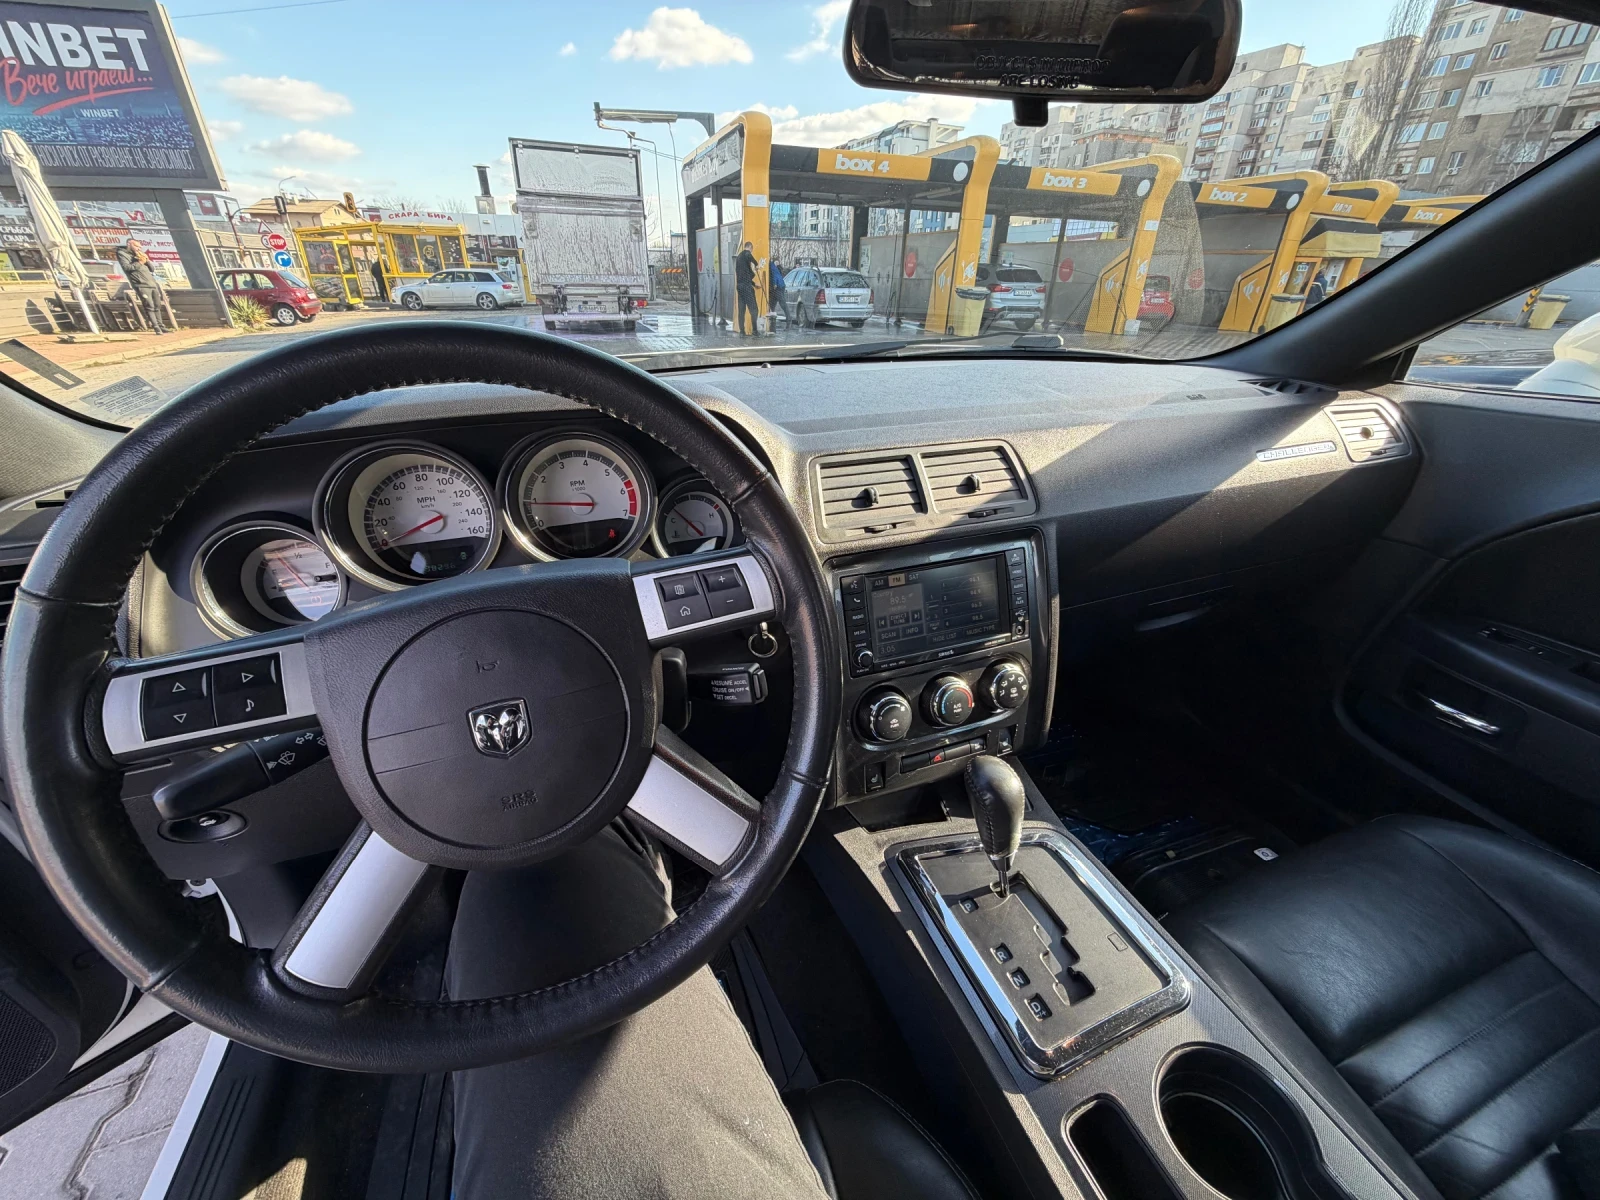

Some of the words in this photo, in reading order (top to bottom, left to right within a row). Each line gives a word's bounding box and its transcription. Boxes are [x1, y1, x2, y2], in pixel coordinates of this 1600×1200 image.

[0, 56, 60, 106] Вече
[999, 73, 1028, 87] ARE
[80, 108, 119, 118] WINBET
[34, 144, 62, 167] НОСИ
[55, 145, 84, 167] РИСК
[77, 146, 92, 168] ОТ
[88, 146, 138, 168] РАЗВИВАНЕ
[130, 147, 148, 168] НА
[143, 147, 195, 170] ЗАВИСИМОСТ
[835, 153, 876, 172] box
[877, 160, 890, 173] 4
[1042, 172, 1076, 188] box
[1077, 177, 1088, 189] 3
[1209, 187, 1238, 202] box
[1237, 192, 1248, 203] 2
[388, 211, 420, 220] СКАРА
[427, 211, 454, 222] БИРА
[1413, 209, 1436, 221] box
[1436, 213, 1443, 222] 1
[0, 225, 33, 234] СРЪБСК
[269, 238, 285, 247] STOP
[560, 461, 565, 469] 3
[582, 459, 589, 467] 4
[604, 468, 610, 477] 5
[415, 473, 428, 482] 80
[436, 477, 454, 487] 100
[541, 476, 547, 484] 2
[392, 481, 406, 491] 60
[569, 480, 585, 488] RPM
[453, 489, 471, 498] 120
[377, 498, 391, 506] 40
[416, 495, 436, 504] MPH
[465, 507, 483, 516] 140
[622, 509, 628, 517] 7
[375, 518, 388, 527] 20
[538, 520, 544, 528] 0
[467, 525, 485, 535] 160
[381, 538, 389, 547] 0
[908, 573, 920, 581] SAT
[874, 579, 884, 587] AM
[889, 595, 907, 605] 89.5
[890, 612, 907, 621] DIRECT
[905, 626, 919, 635] INFO
[966, 627, 983, 636] MUSIC
[983, 624, 996, 632] TYPE
[881, 631, 897, 640] SCAN
[932, 634, 945, 643] HIDE
[946, 632, 957, 640] LIST
[501, 789, 537, 805] SRS
[964, 902, 972, 912] P
[996, 951, 1007, 961] R
[1013, 974, 1025, 986] N
[1030, 1001, 1042, 1013] D
